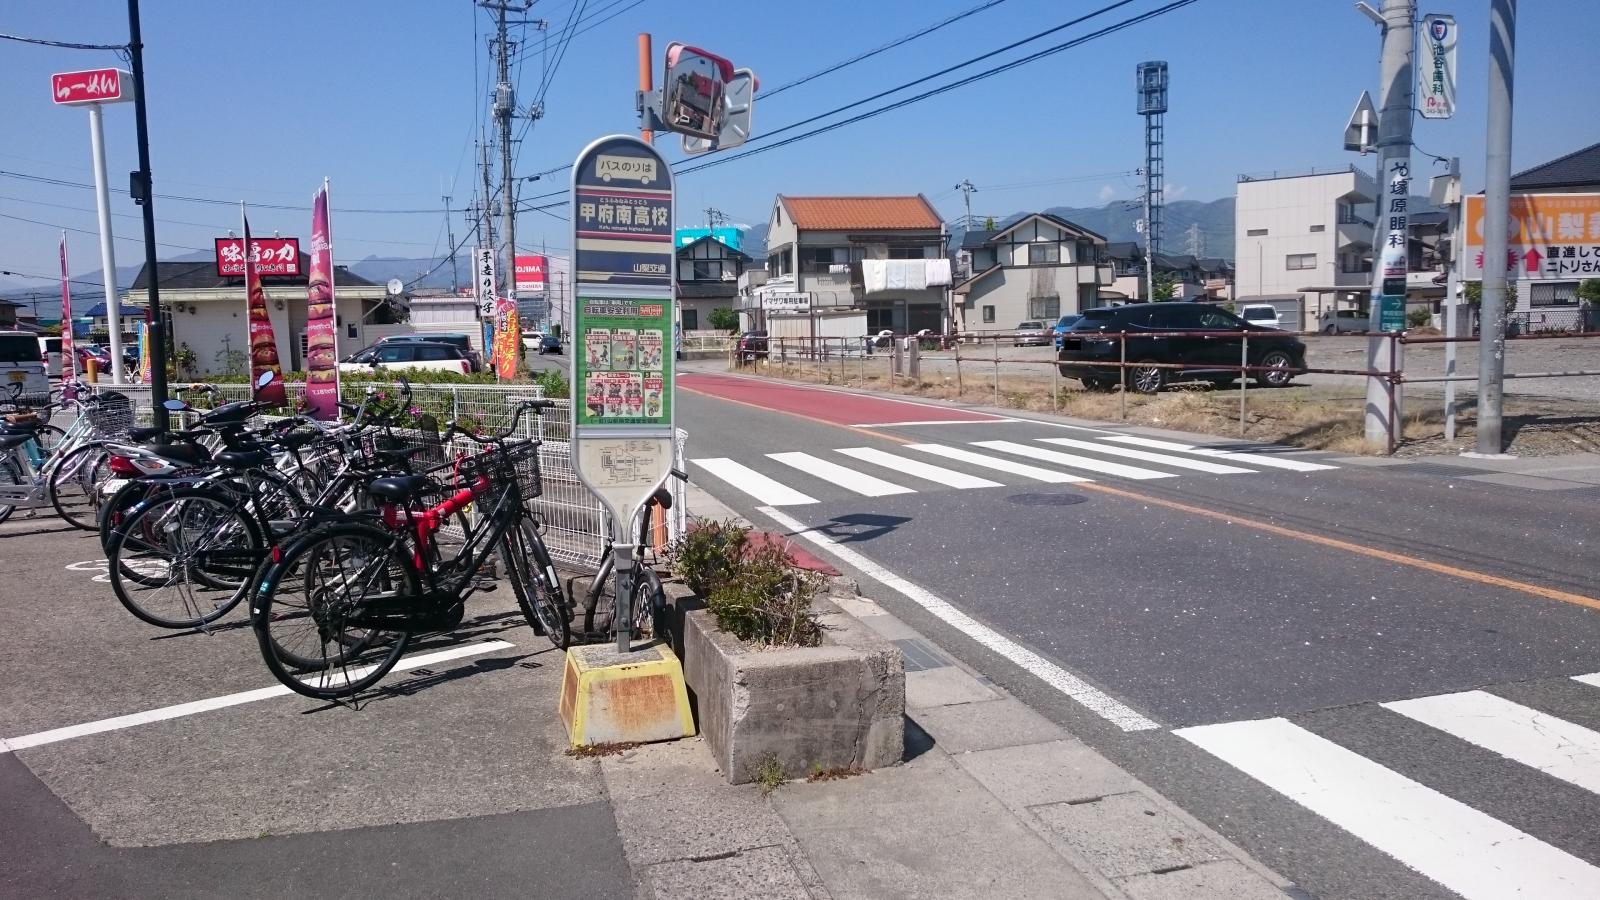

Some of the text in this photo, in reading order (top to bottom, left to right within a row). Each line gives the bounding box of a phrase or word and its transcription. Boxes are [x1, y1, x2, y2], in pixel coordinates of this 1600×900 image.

[57, 74, 117, 99] らーめん
[580, 203, 668, 226] 甲府南高校
[633, 263, 666, 273] 山梨交通
